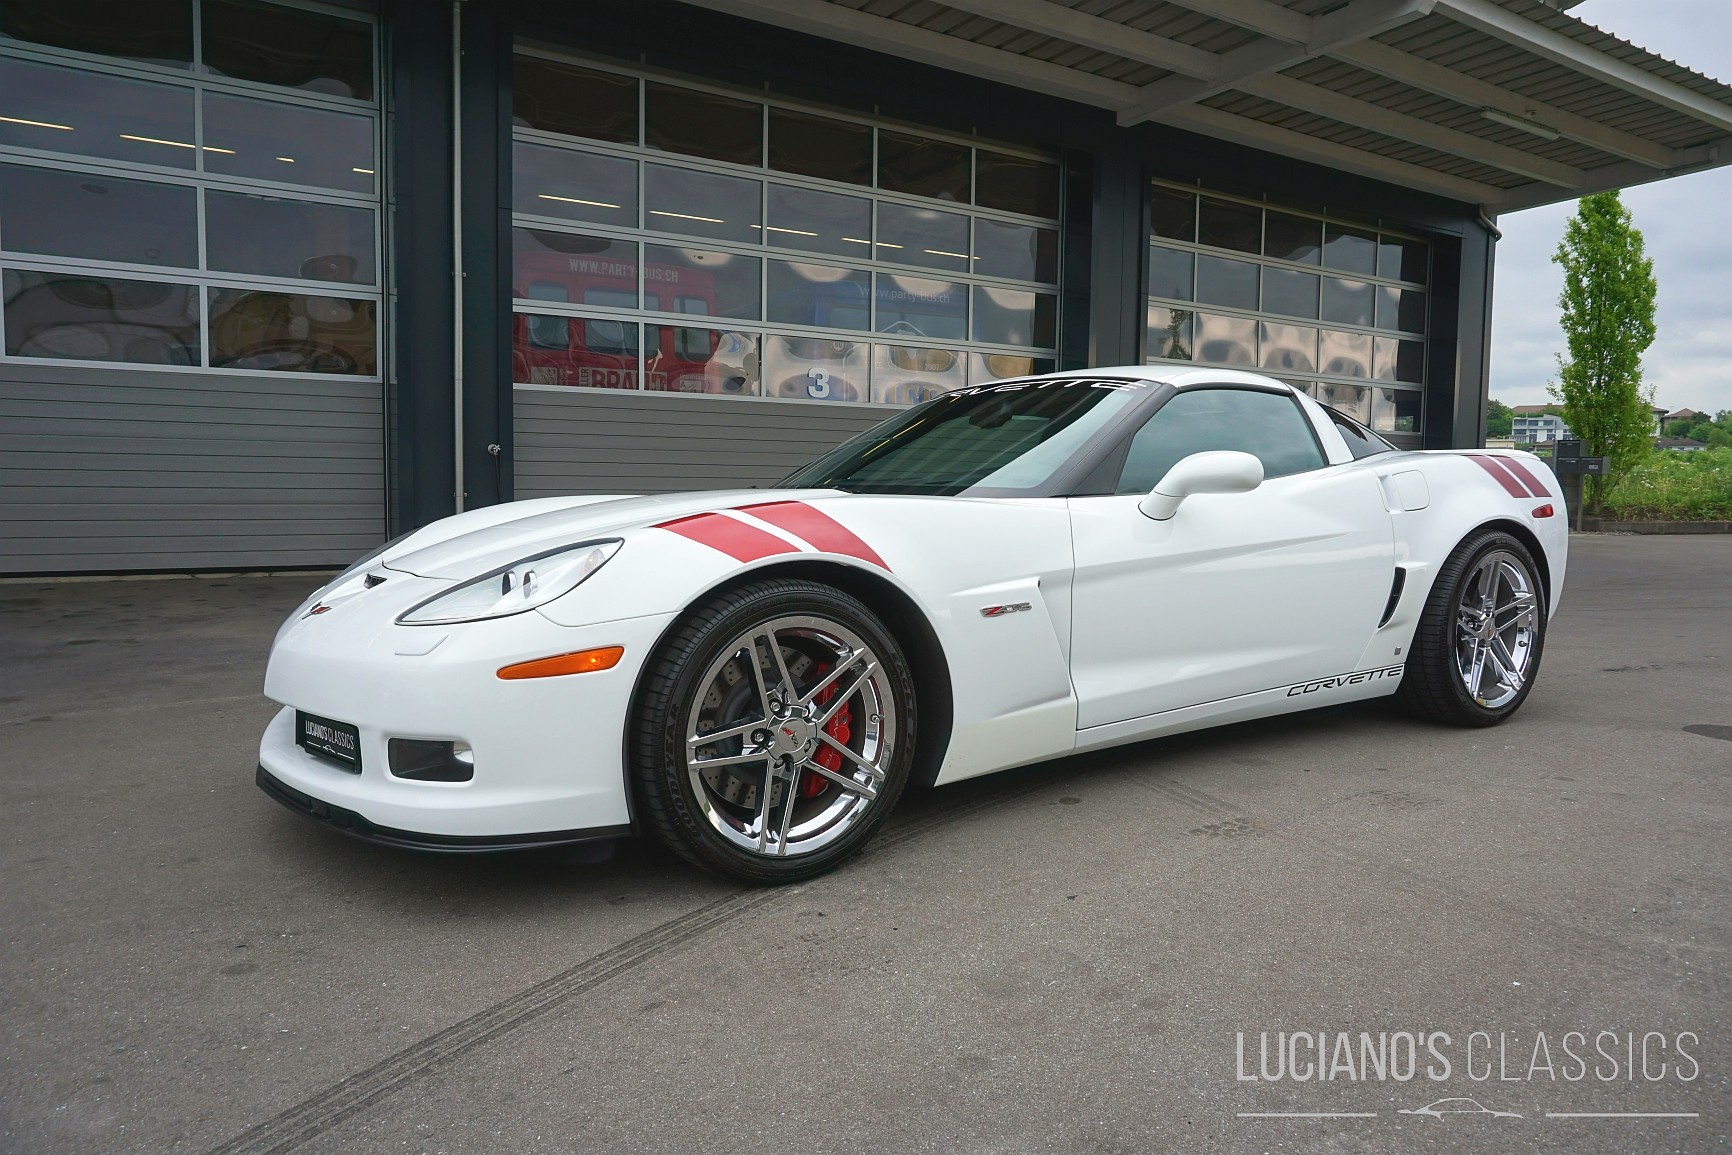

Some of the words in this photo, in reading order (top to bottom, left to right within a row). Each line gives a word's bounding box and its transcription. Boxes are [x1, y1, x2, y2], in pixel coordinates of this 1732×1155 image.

[808, 367, 830, 398] 3
[1286, 664, 1404, 697] CORVETTE
[327, 727, 355, 750] CLASSICS
